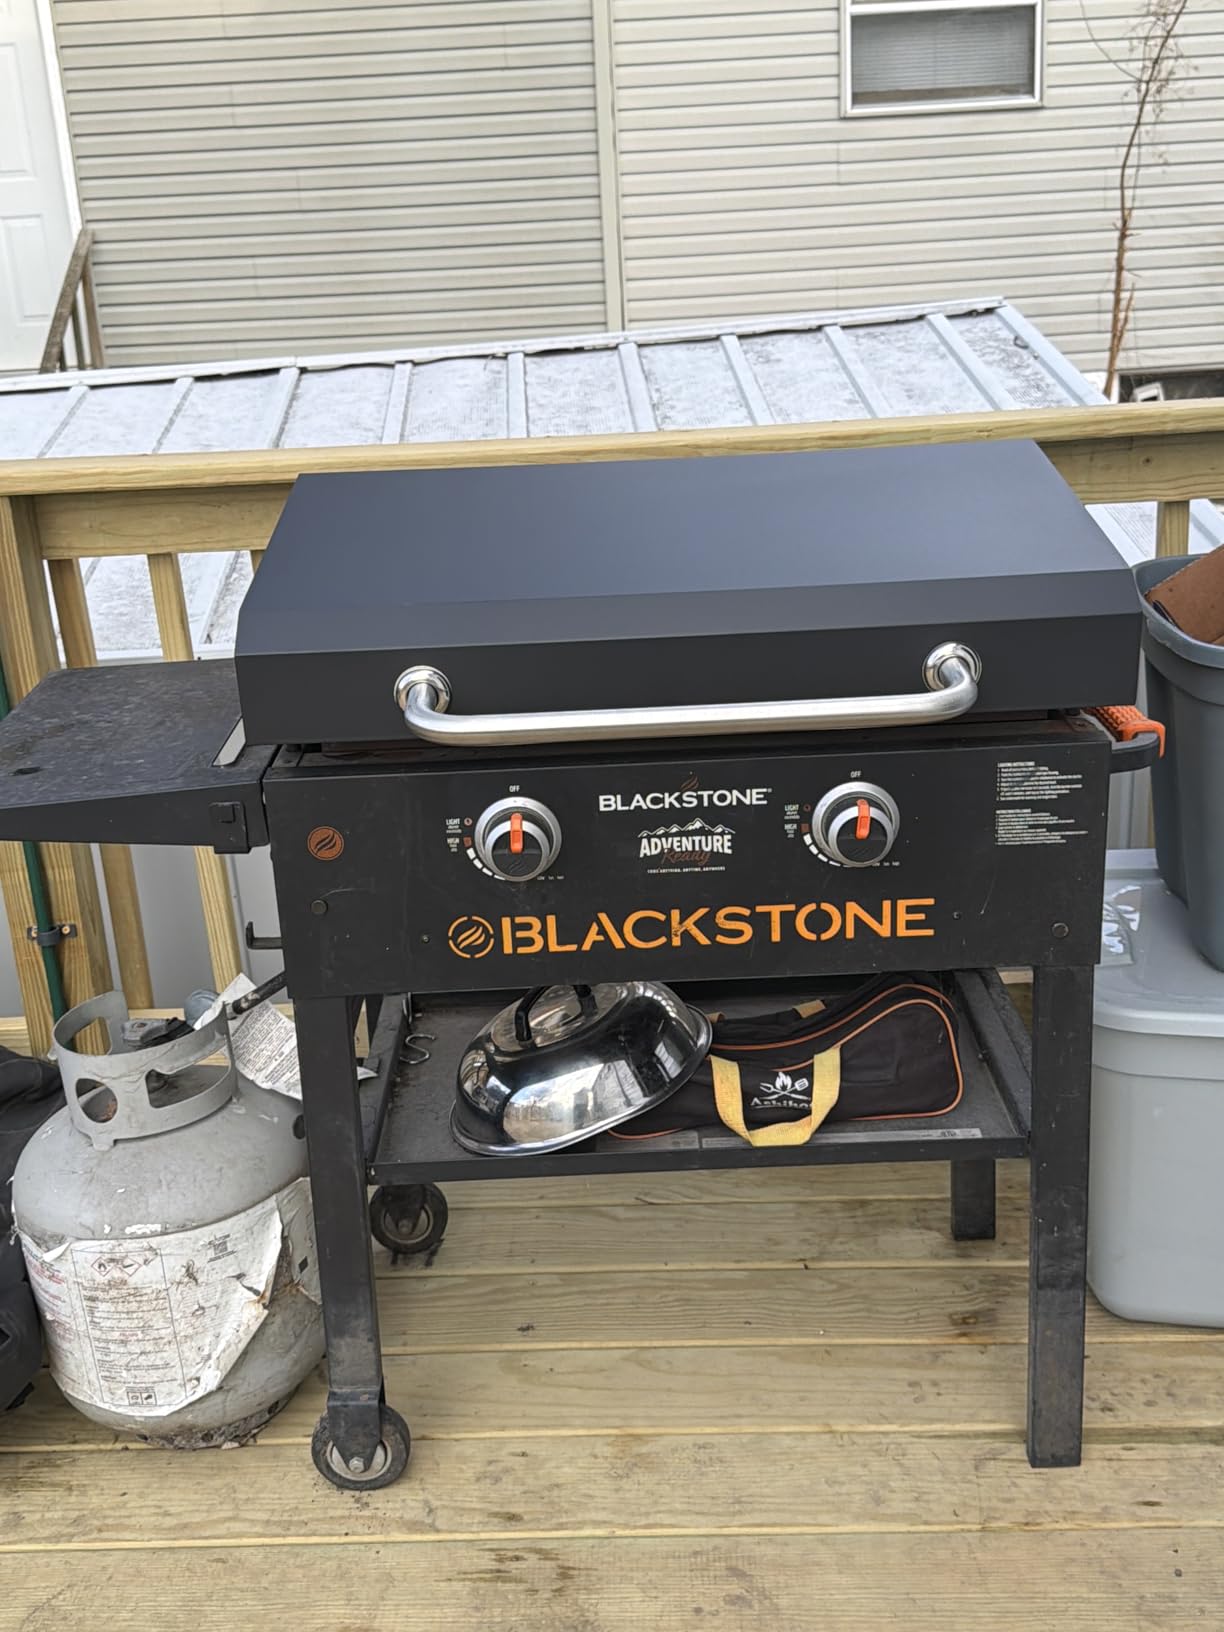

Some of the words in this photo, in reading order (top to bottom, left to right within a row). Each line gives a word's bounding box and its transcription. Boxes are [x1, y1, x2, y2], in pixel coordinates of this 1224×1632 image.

[850, 770, 862, 778] OFF
[508, 784, 521, 793] OFF
[784, 804, 800, 812] LIGHT
[445, 818, 461, 826] LIGHT
[639, 833, 733, 859] ADVENTURE
[501, 897, 936, 955] BLACKSTONE
